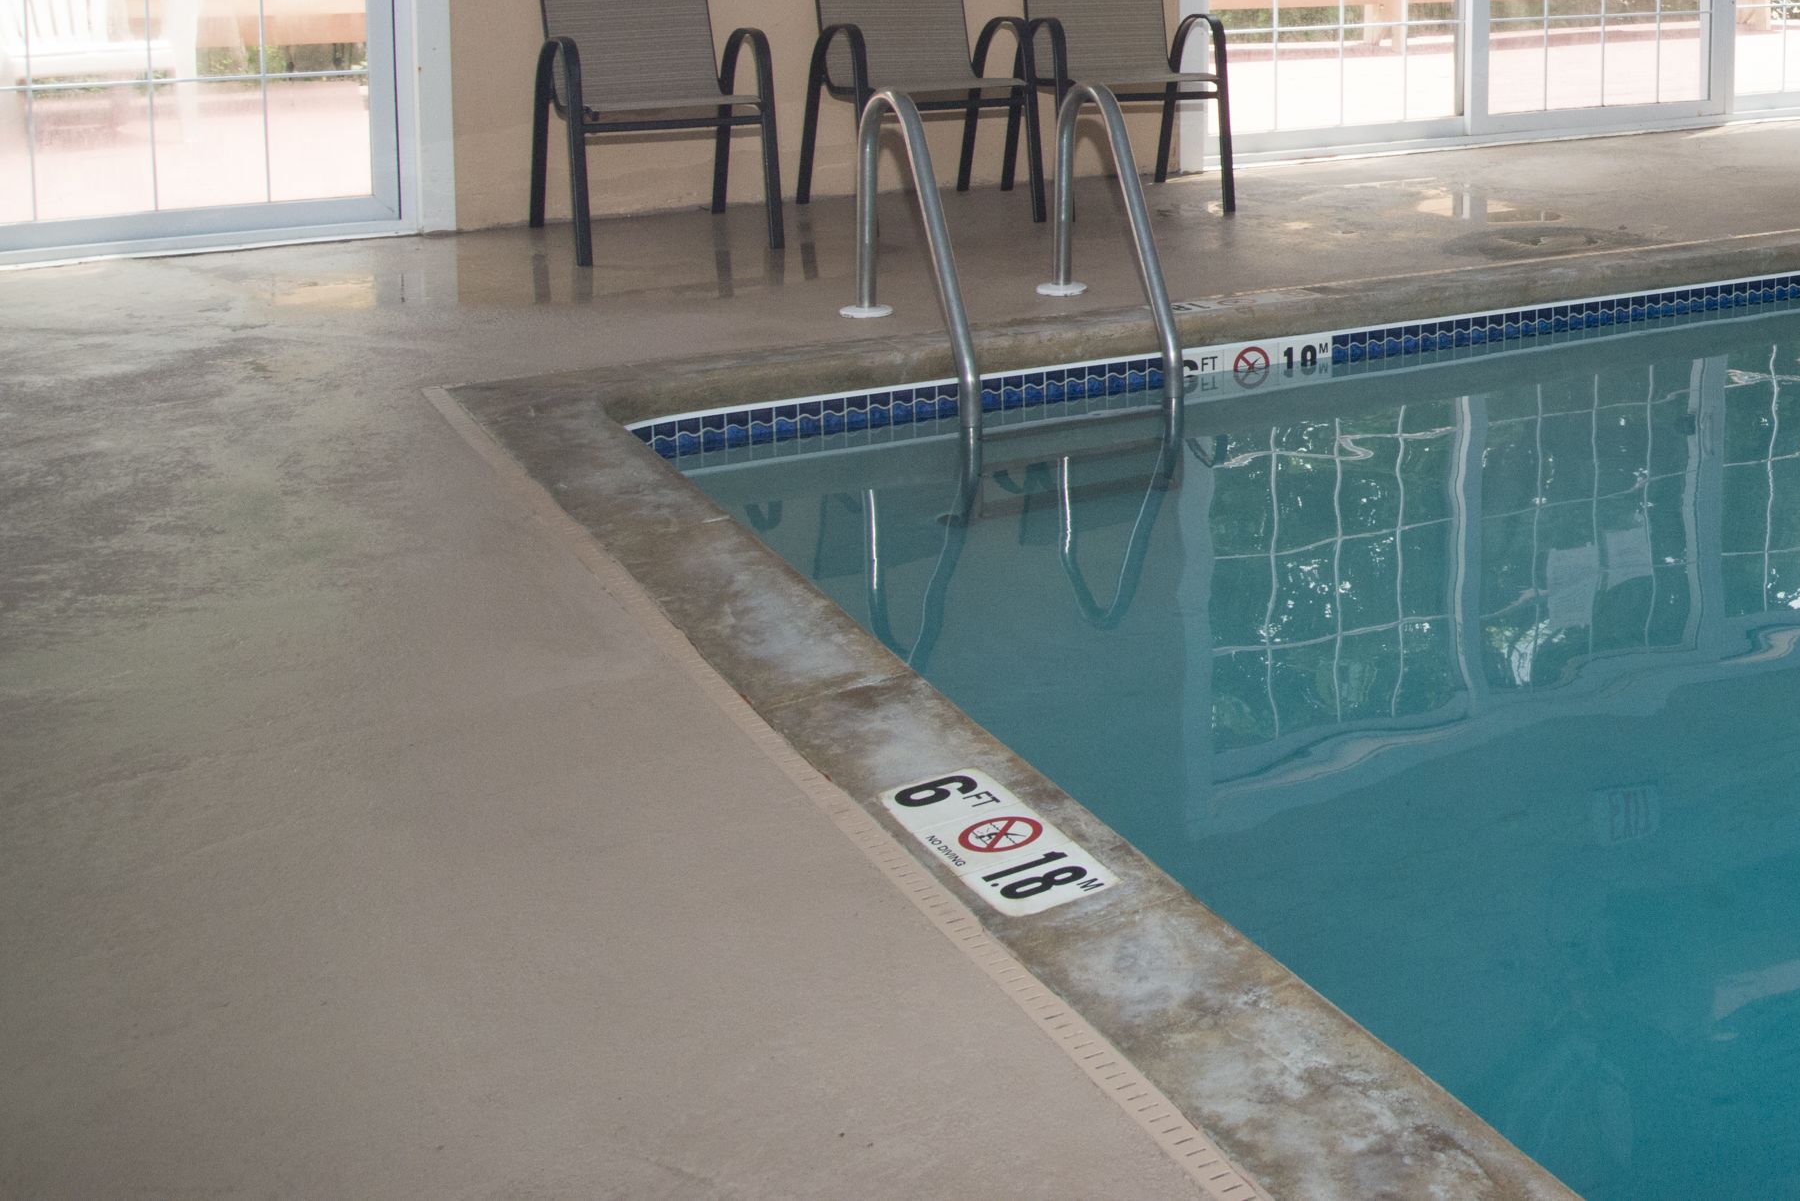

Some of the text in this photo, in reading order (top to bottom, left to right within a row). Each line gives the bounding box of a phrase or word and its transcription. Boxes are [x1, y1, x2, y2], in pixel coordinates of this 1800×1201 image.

[1201, 355, 1218, 372] FT
[1319, 342, 1329, 354] M
[895, 775, 1001, 808] 6 FT
[925, 834, 966, 867] NO DIVING
[981, 851, 1105, 899] 1.8 M
